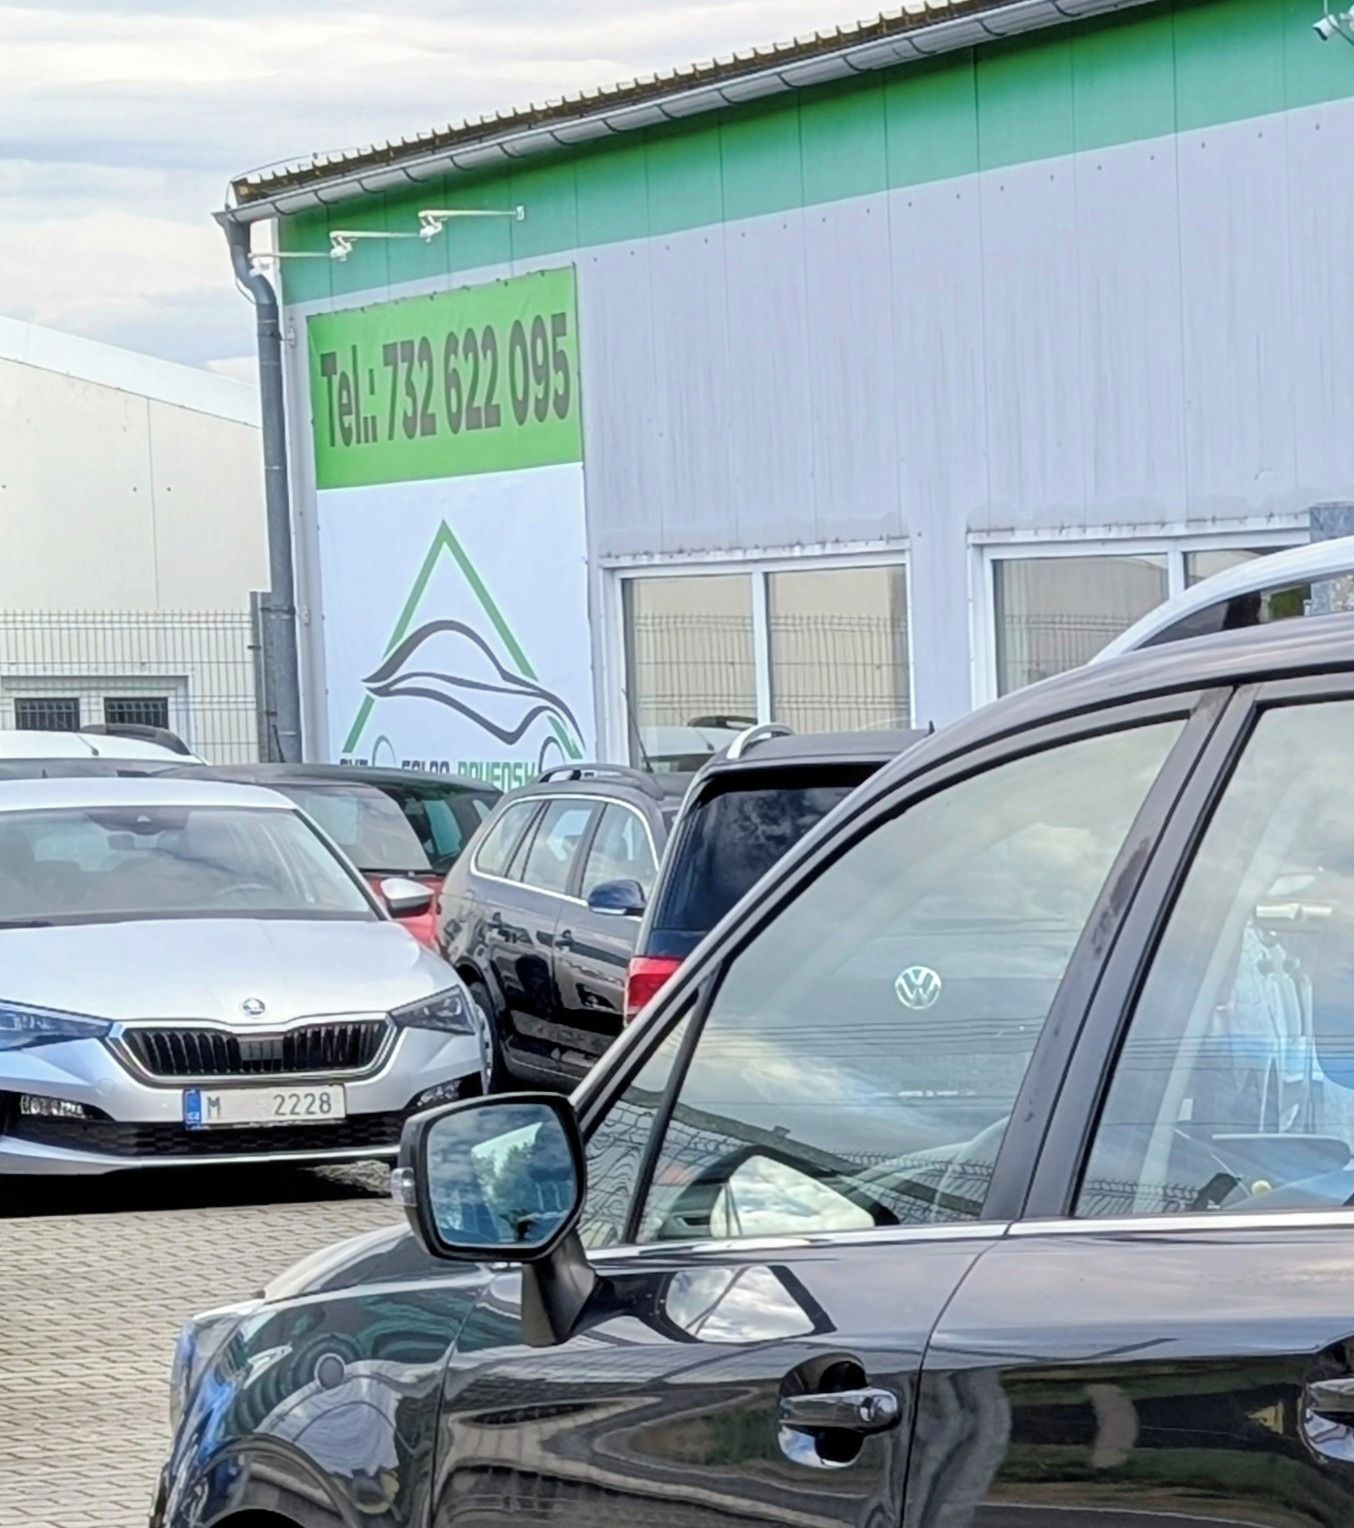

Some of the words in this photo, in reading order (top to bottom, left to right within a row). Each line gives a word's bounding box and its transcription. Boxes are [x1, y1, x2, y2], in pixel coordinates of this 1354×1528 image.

[320, 344, 378, 447] Tel.:
[382, 336, 437, 440] 732
[444, 325, 501, 434] 622
[509, 312, 571, 426] 095
[272, 1092, 332, 1116] 2228
